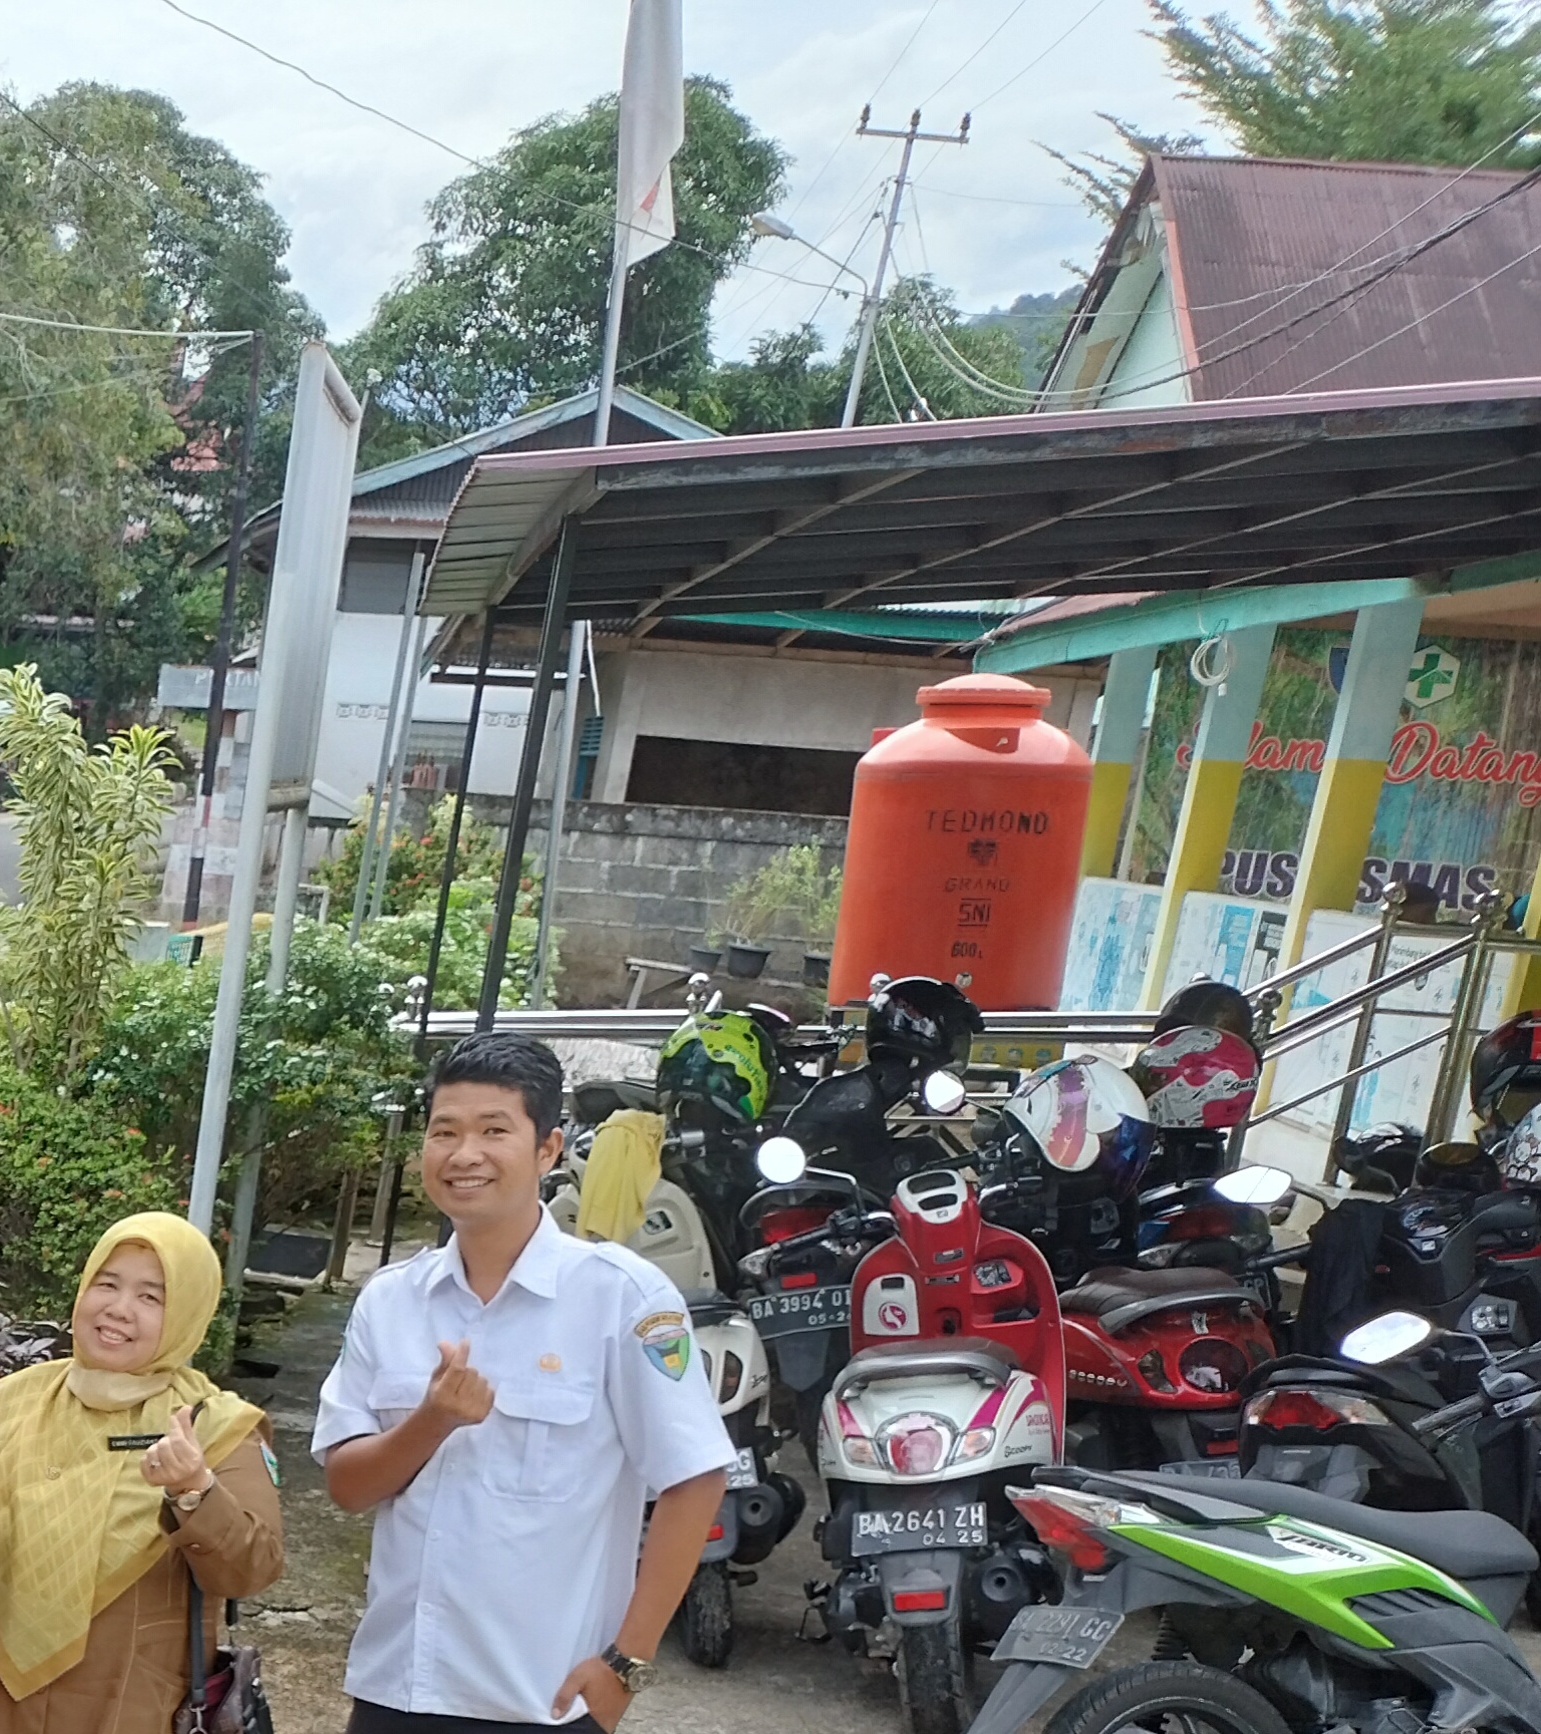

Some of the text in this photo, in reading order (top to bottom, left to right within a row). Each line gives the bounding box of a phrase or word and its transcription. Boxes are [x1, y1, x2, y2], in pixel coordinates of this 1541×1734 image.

[926, 809, 1049, 835] TEDMOND
[944, 877, 1010, 893] GRAND
[958, 902, 992, 923] SNI
[751, 1299, 774, 1320] BA
[779, 1288, 826, 1314] 3994
[858, 1504, 984, 1535] BA 2641 ZH
